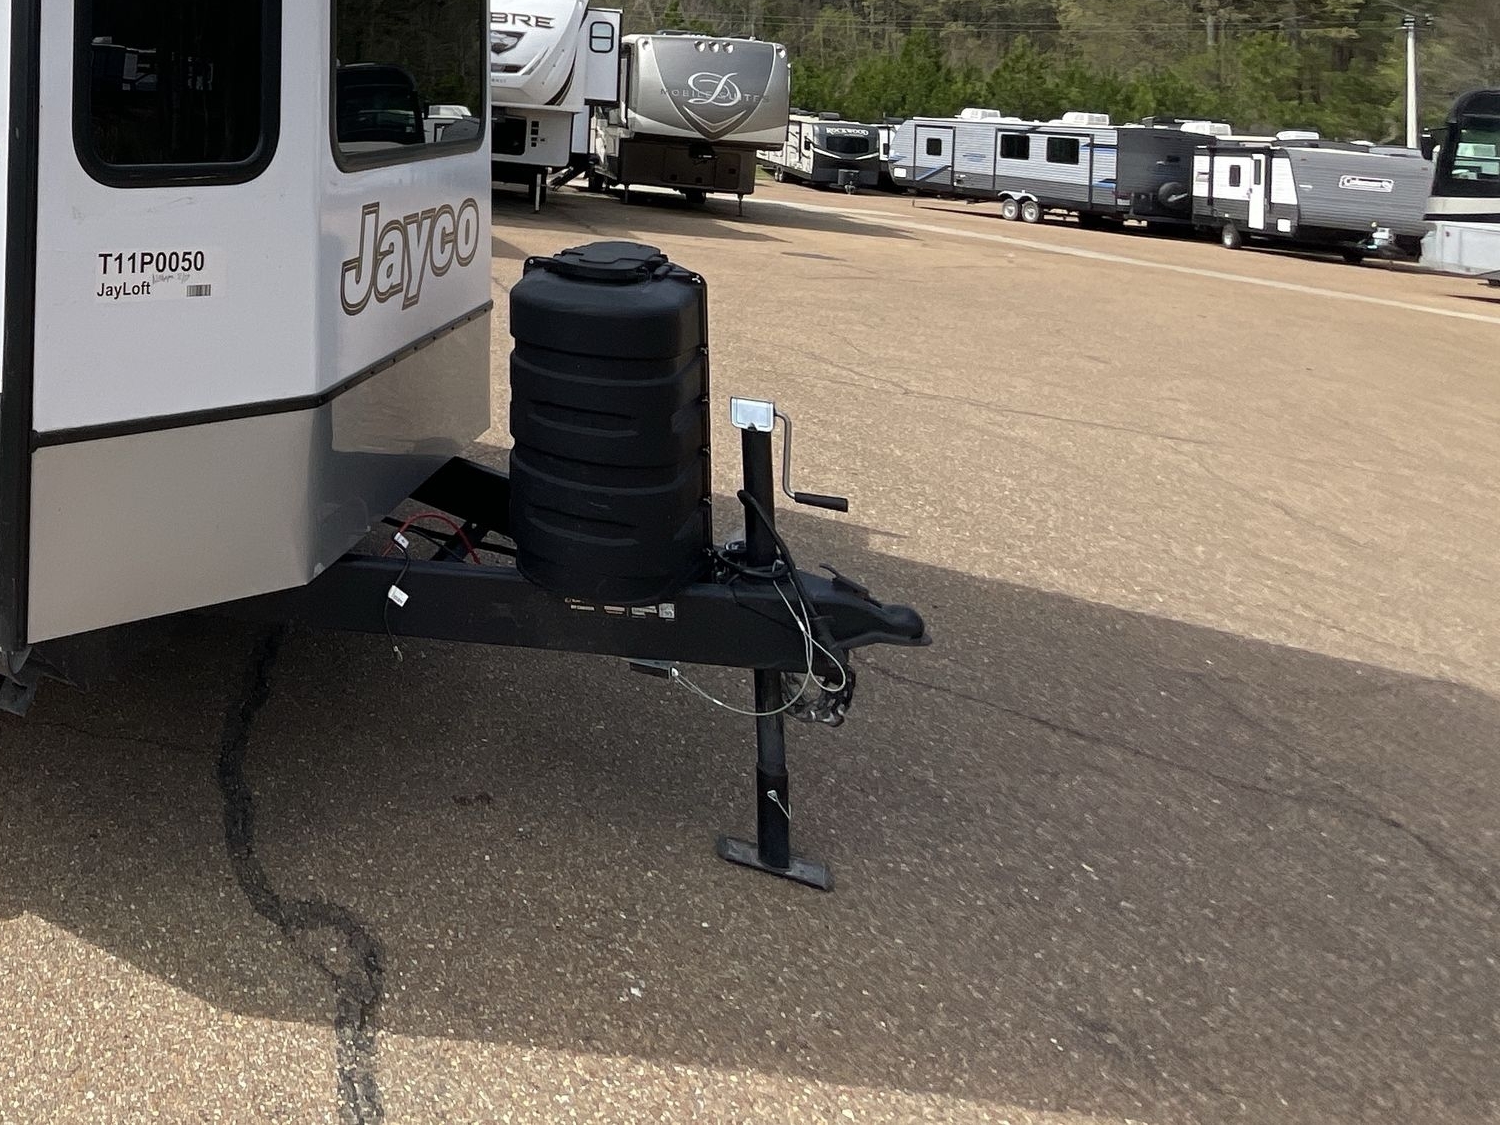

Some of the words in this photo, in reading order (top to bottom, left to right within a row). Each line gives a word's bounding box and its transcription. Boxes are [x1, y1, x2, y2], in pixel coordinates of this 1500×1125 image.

[826, 127, 869, 136] ROCKWOOD
[98, 250, 205, 274] T11P0050
[340, 197, 479, 316] Jayco
[97, 281, 151, 300] JayLoft
